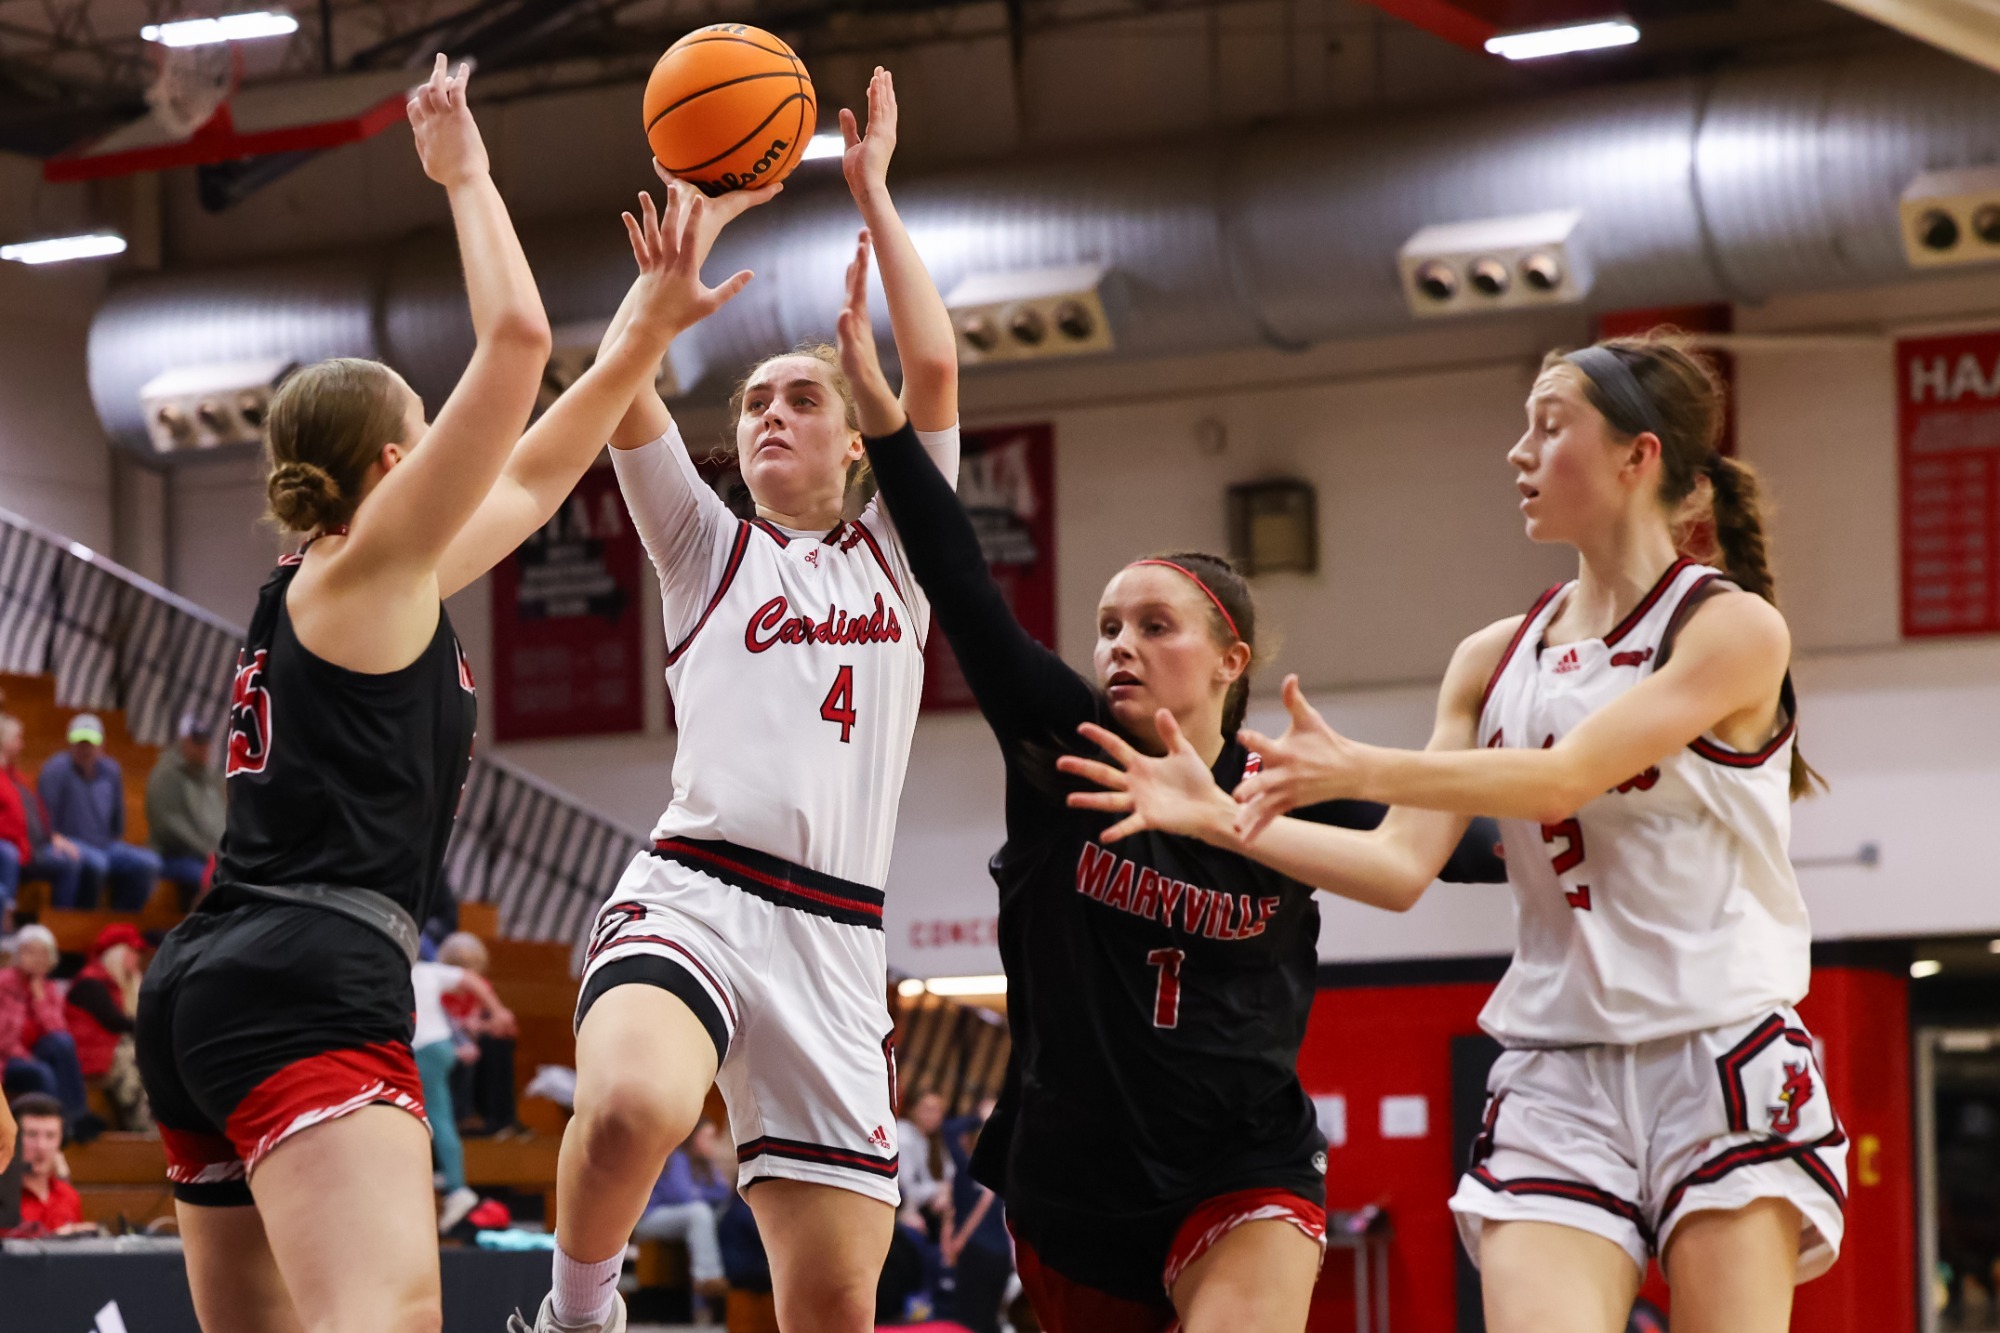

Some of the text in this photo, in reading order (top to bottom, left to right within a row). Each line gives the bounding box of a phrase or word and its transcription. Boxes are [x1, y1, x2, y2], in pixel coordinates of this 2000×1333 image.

[819, 664, 857, 744] 4
[1075, 840, 1281, 941] MARYVILLE
[1541, 818, 1592, 911] 2
[1146, 946, 1186, 1030] 1
